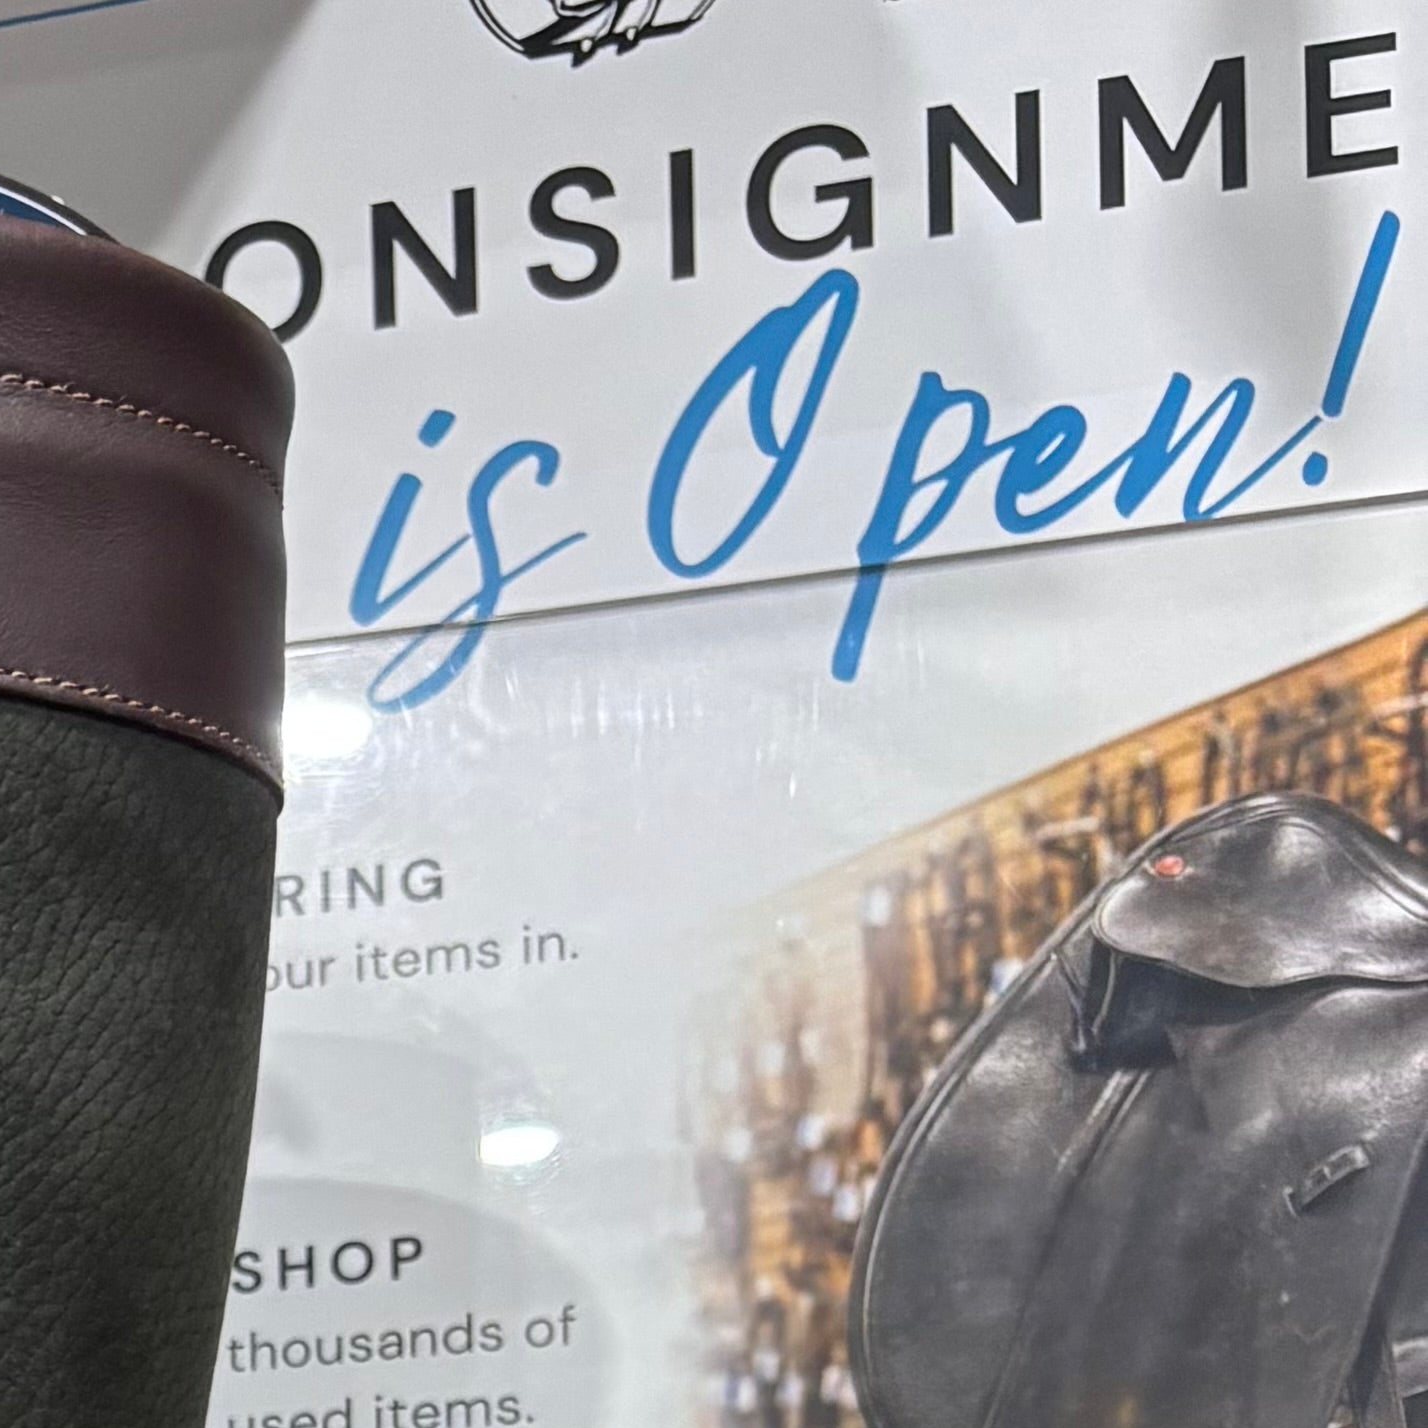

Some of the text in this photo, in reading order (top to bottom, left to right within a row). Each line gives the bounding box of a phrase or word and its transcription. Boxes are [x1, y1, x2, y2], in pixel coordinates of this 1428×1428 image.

[350, 210, 1400, 715] is Open!
[275, 858, 444, 917] RING
[355, 939, 502, 983] items
[522, 923, 579, 966] in.
[232, 1235, 424, 1295] SHOP
[227, 1304, 578, 1373] thousands of
